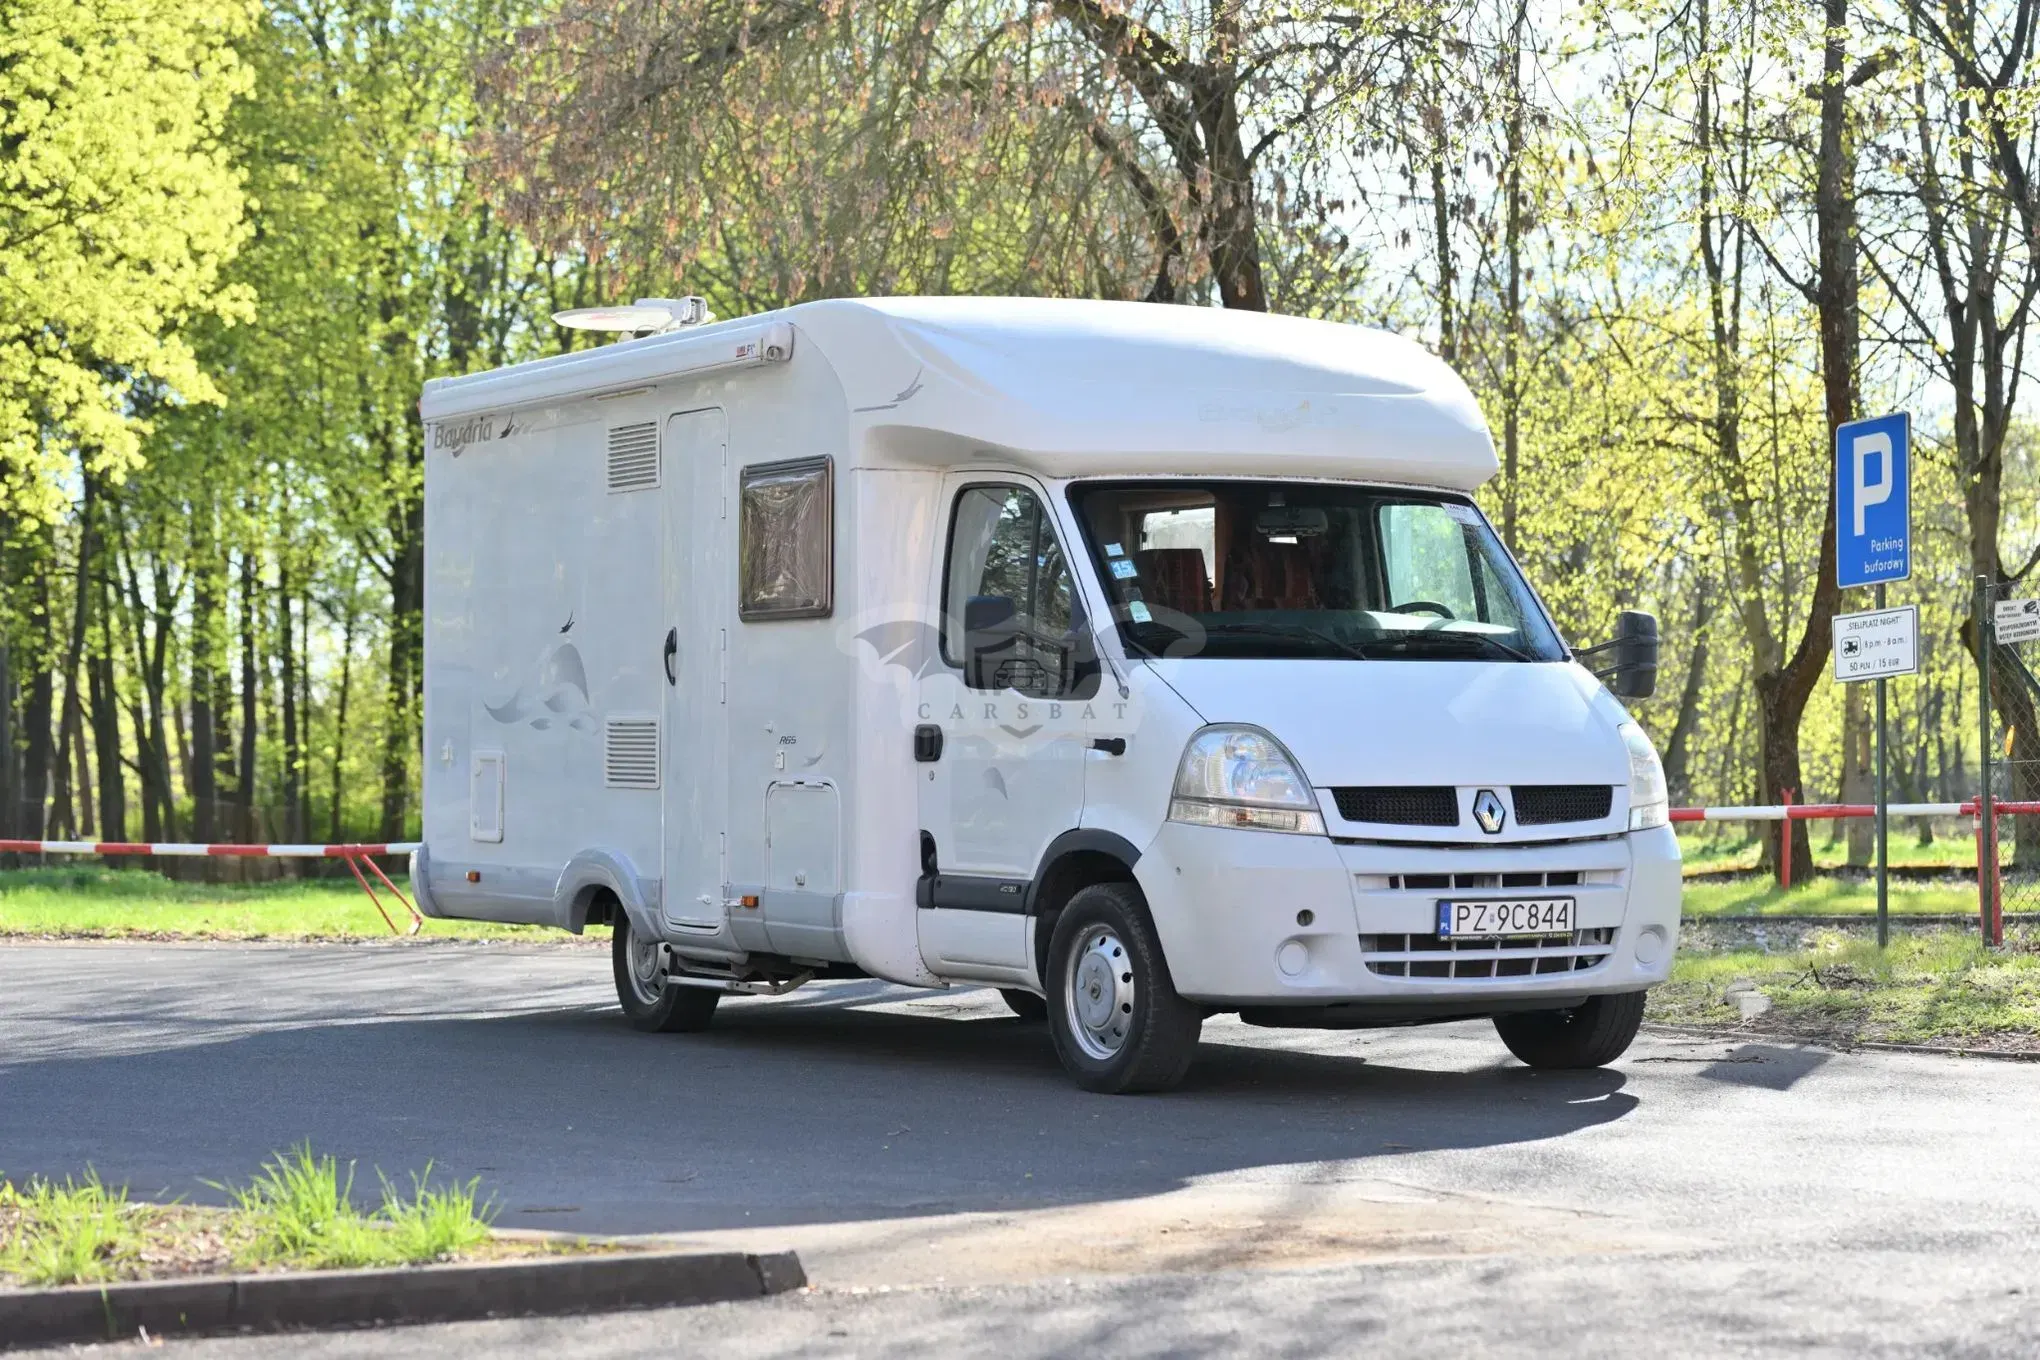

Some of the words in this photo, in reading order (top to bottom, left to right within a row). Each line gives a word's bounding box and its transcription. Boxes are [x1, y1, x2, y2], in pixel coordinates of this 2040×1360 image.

[1853, 431, 1893, 537] P
[1870, 537, 1904, 552] Parking
[1864, 557, 1904, 574] buforowy
[1849, 661, 1858, 672] 50
[1879, 657, 1887, 668] 15
[1456, 905, 1488, 931] PZ
[1497, 903, 1568, 931] 9C844
[1440, 922, 1449, 930] PL
